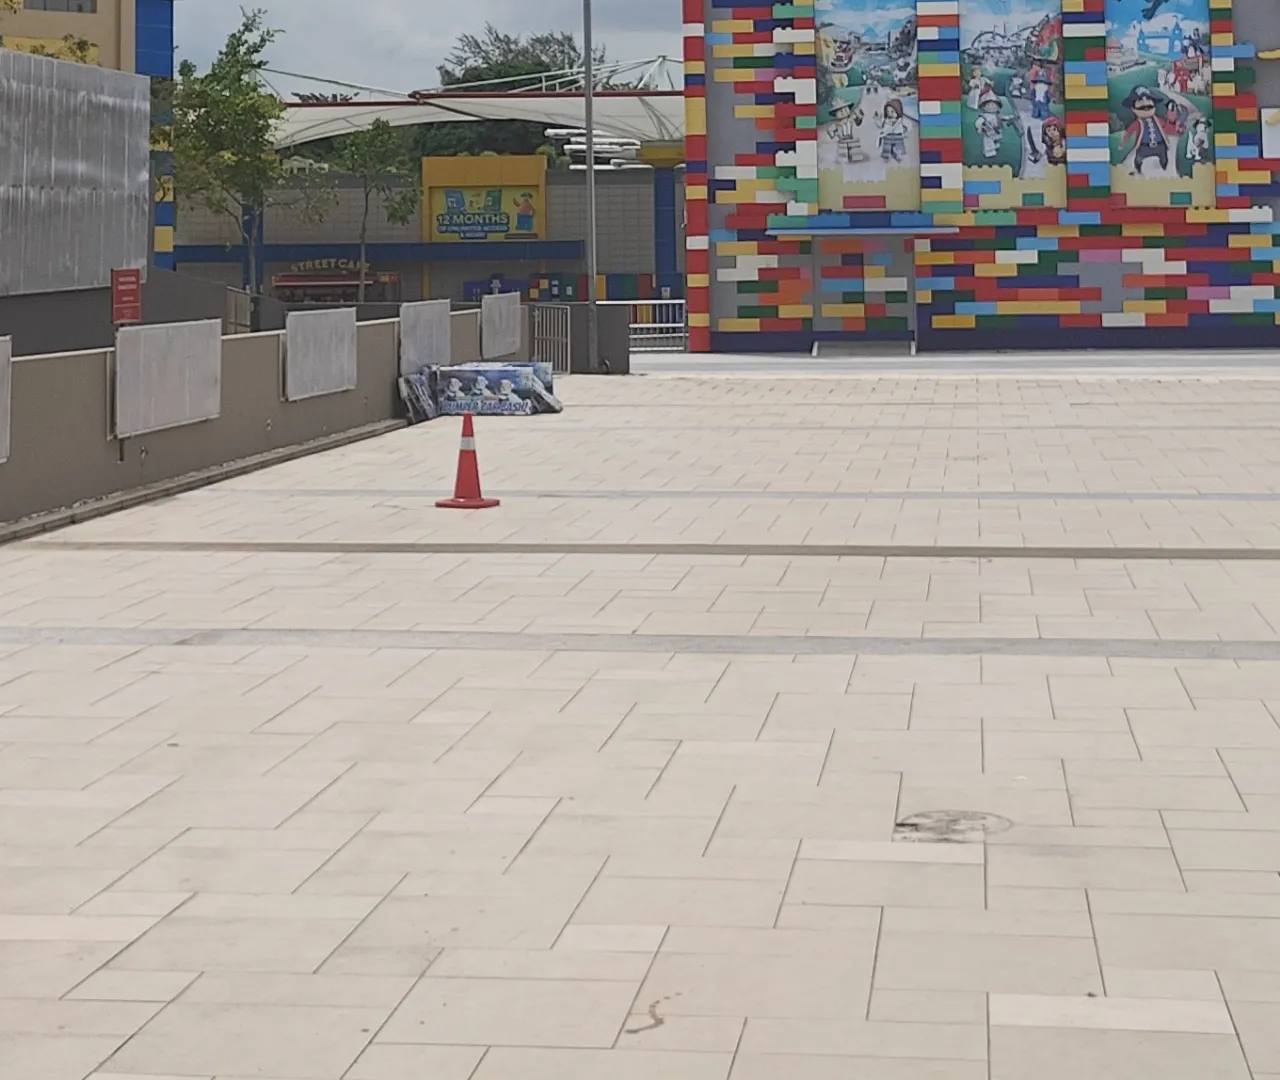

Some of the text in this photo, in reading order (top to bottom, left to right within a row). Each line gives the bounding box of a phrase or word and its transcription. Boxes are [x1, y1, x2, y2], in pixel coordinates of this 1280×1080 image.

[438, 213, 508, 224] 12 MONTHS
[291, 259, 337, 272] STREET
